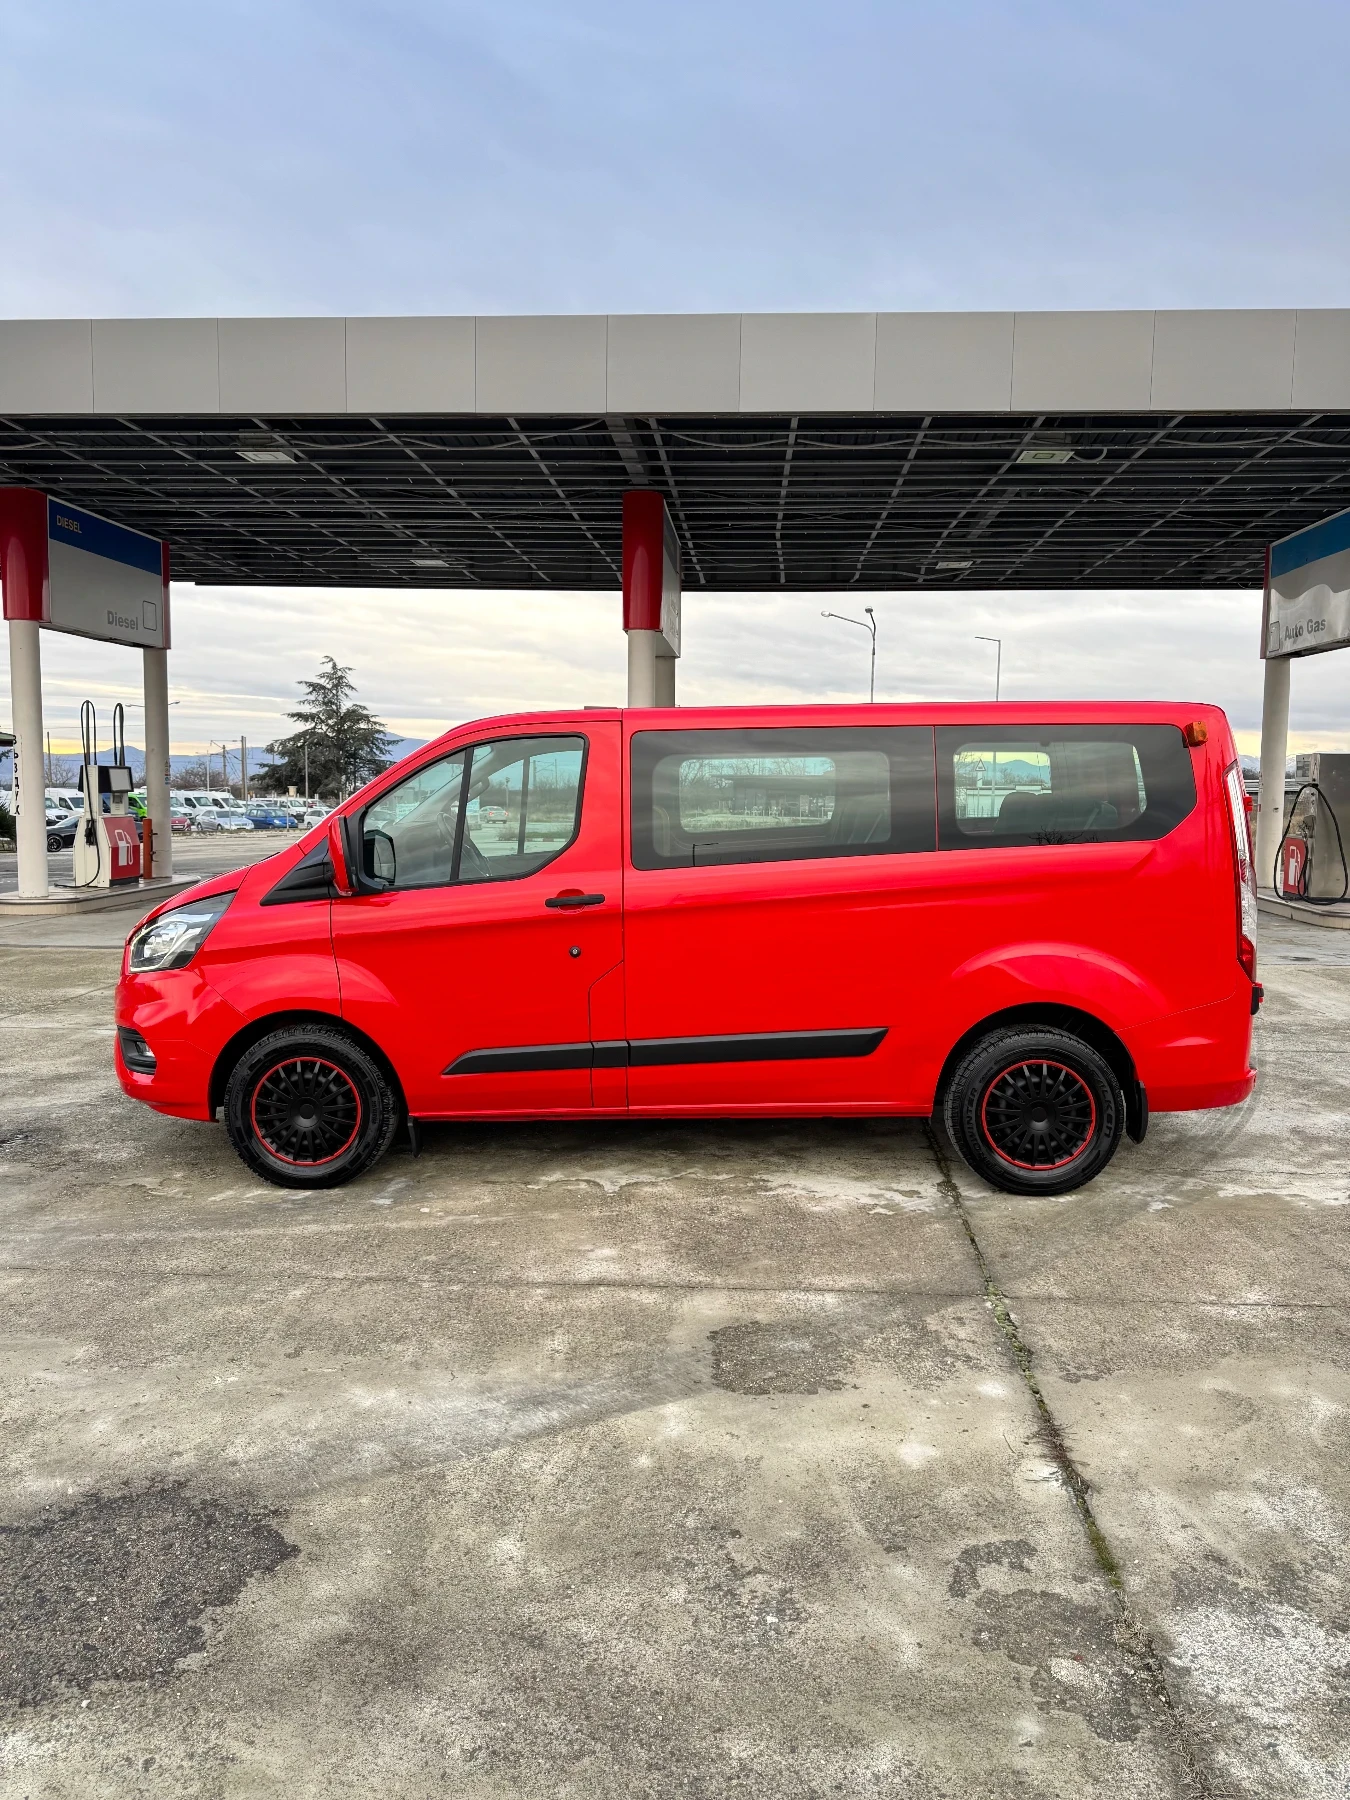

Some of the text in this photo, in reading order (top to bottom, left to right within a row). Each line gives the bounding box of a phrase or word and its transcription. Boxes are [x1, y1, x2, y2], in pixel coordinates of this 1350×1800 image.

[56, 515, 82, 534] DIESEL
[107, 610, 139, 631] Diesel
[1284, 618, 1326, 641] Auto Gas
